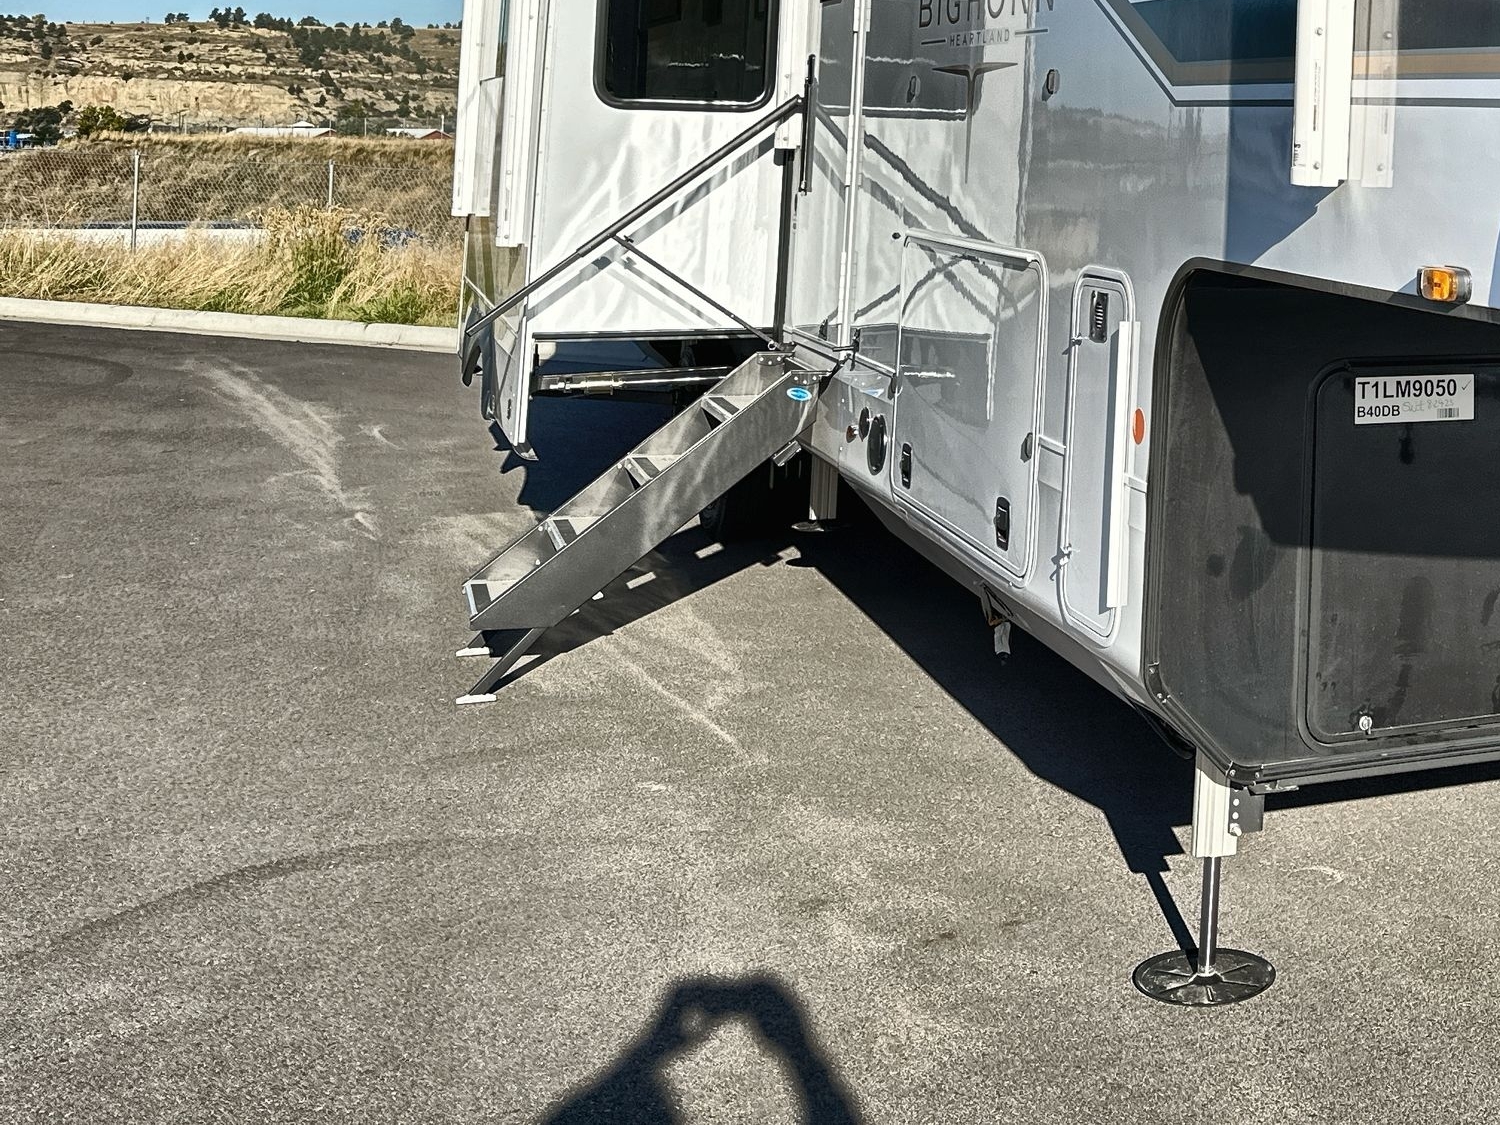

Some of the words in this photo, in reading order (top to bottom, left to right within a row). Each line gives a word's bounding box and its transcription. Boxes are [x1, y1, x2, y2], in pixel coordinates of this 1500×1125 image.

[949, 28, 1011, 47] HEARTLAND
[1357, 379, 1457, 399] T1LM9050
[1357, 405, 1401, 418] B40DB
